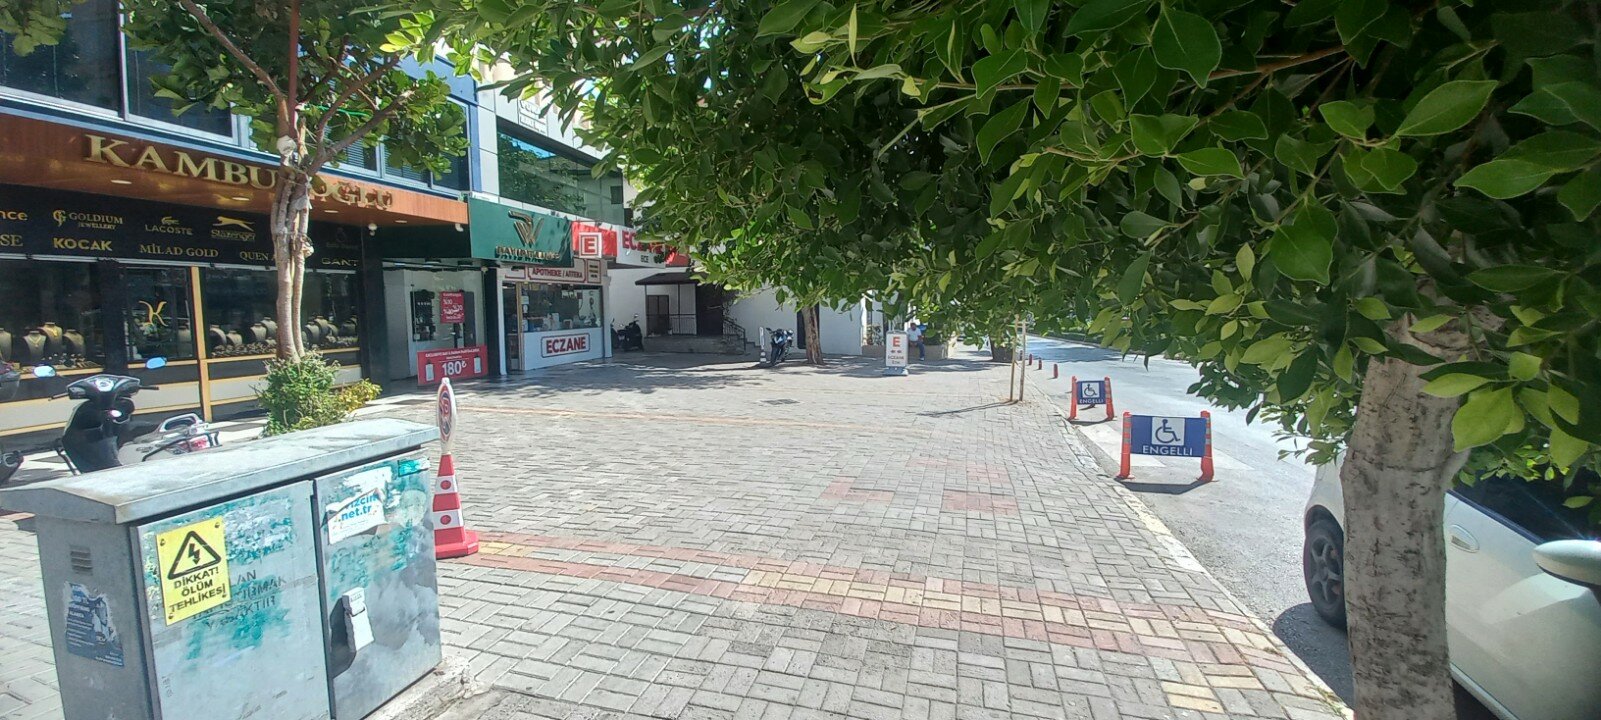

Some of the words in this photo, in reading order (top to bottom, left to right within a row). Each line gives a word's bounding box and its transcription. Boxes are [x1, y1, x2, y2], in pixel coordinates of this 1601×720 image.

[69, 211, 124, 225] GOLDIUM
[145, 224, 193, 235] LACOSTE
[140, 243, 184, 257] MİLAD
[186, 247, 219, 258] GOLD
[584, 237, 598, 254] E
[239, 250, 270, 261] QUEN
[321, 257, 359, 267] GANT
[532, 267, 563, 278] APOTHEKE
[546, 336, 588, 354] ECZANE
[892, 336, 901, 348] E
[1142, 445, 1193, 457] ENGELLI
[173, 566, 219, 589] DİKKAT!
[181, 579, 213, 597] ÖLÜM
